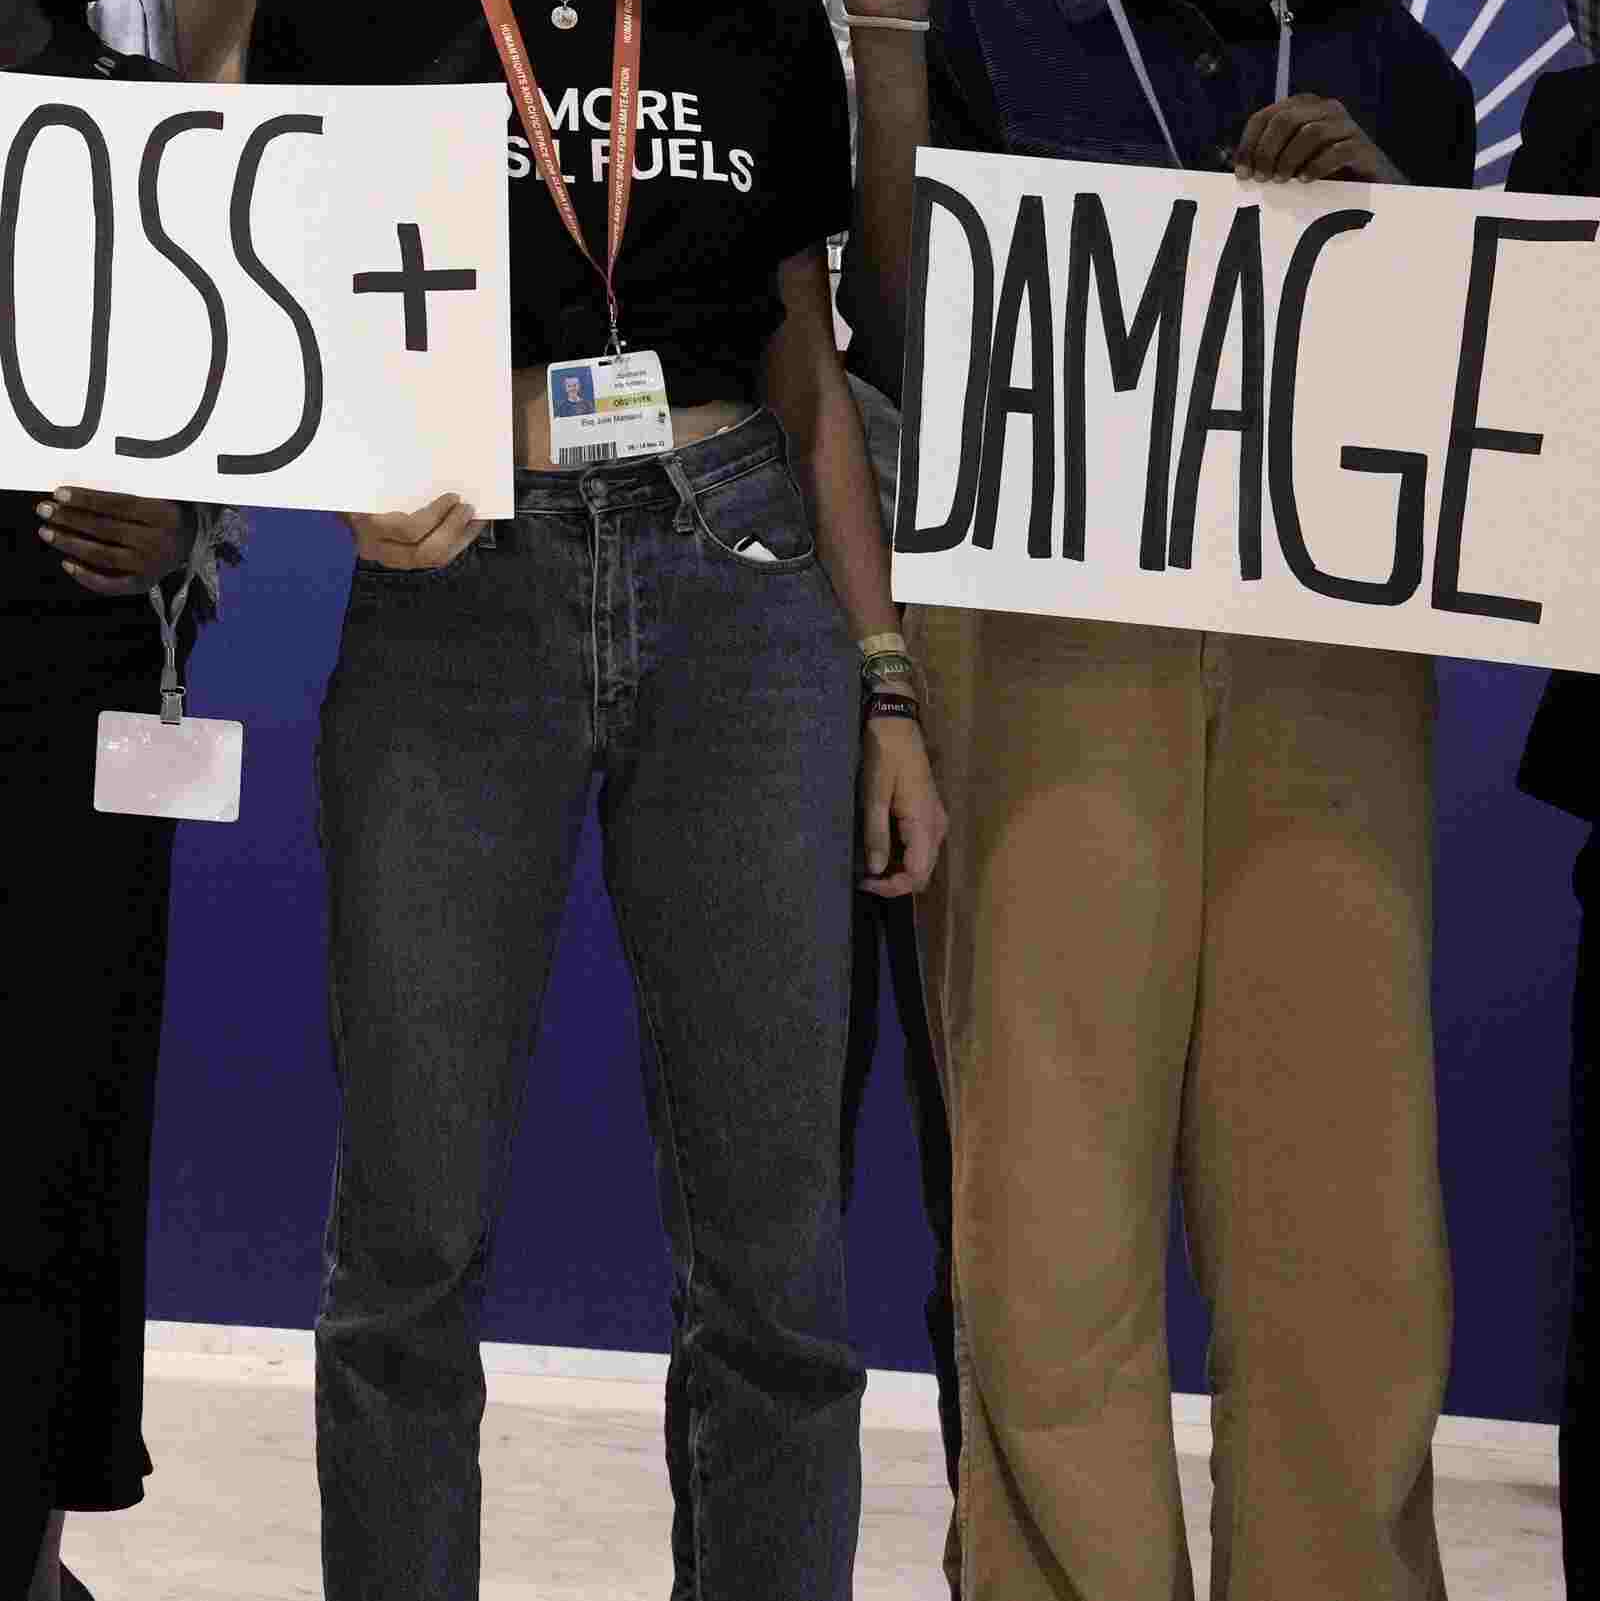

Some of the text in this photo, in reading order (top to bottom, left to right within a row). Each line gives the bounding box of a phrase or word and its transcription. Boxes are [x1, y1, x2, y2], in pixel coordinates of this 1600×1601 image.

[537, 88, 702, 132] MORE
[590, 137, 754, 193] FUELS
[352, 223, 477, 352] +
[894, 175, 1600, 625] DAMAGE
